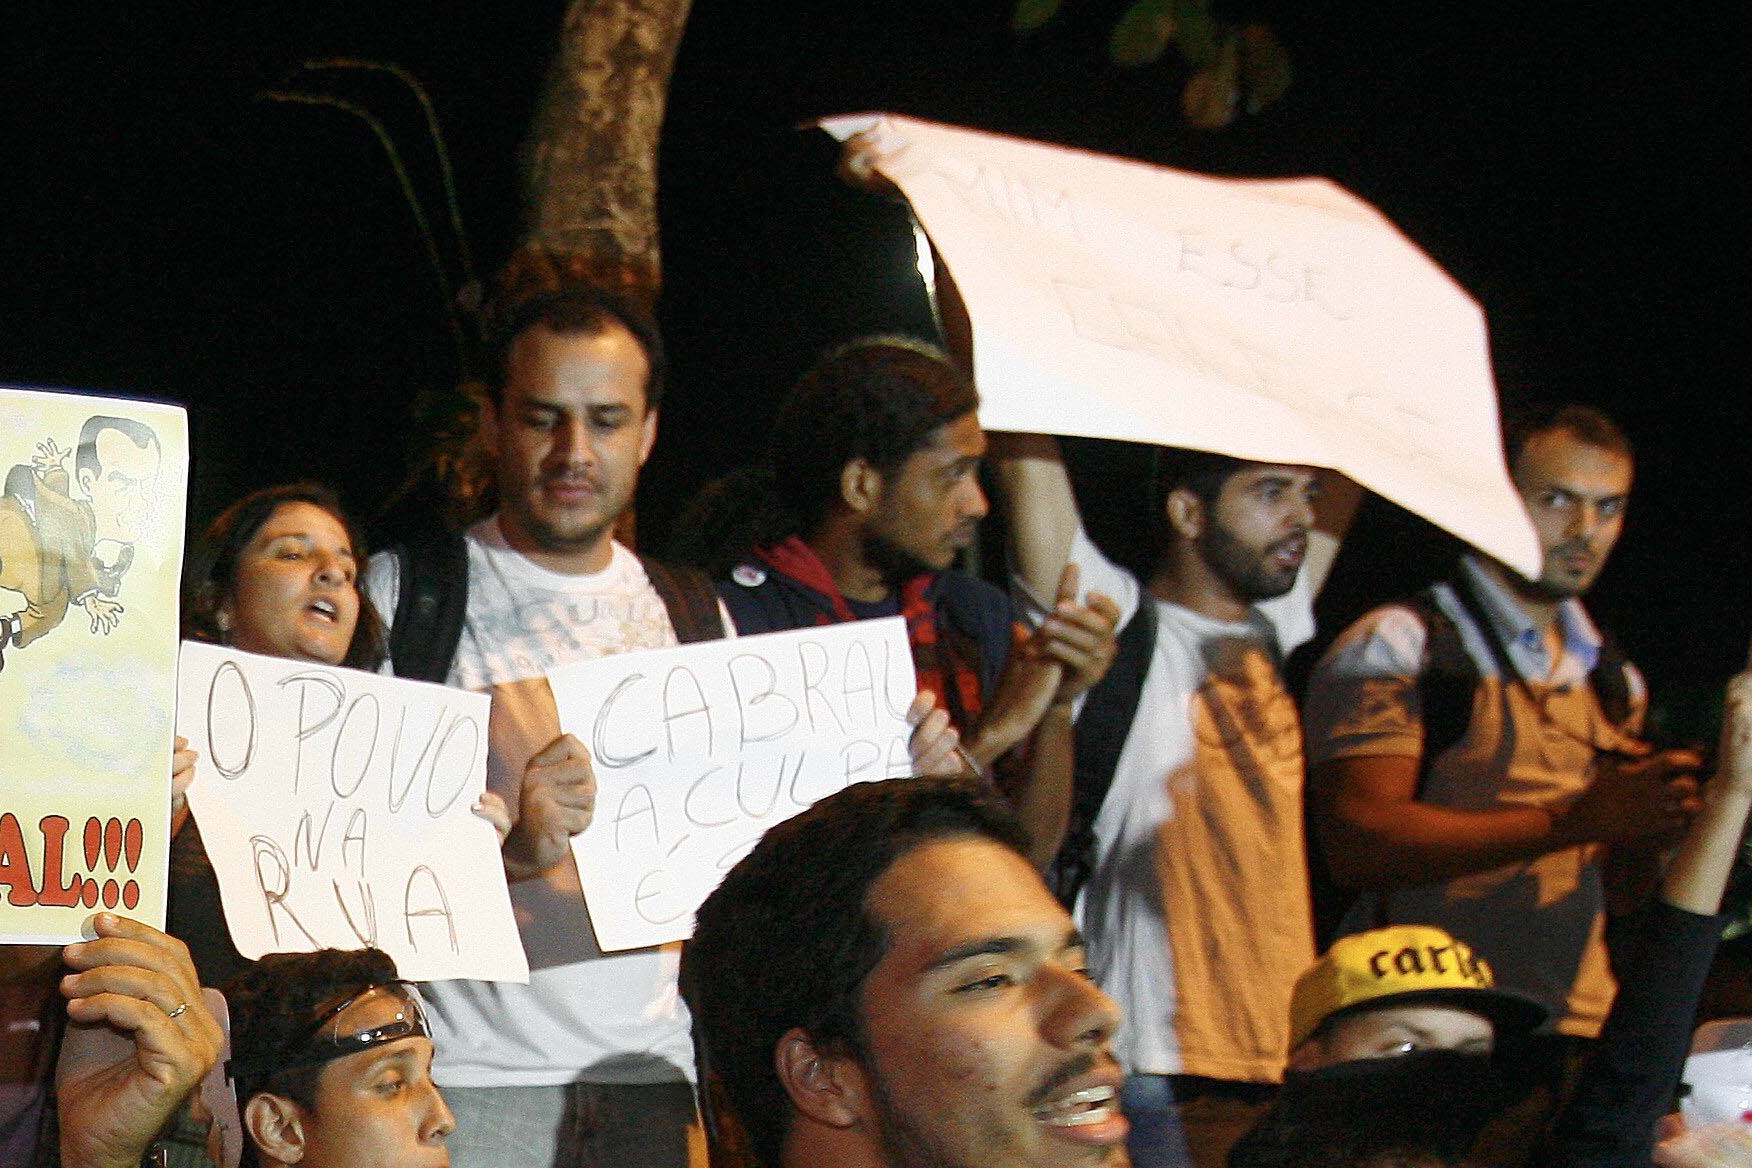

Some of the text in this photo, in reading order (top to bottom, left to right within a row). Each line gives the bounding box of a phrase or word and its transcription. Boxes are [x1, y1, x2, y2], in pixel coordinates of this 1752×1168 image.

[207, 660, 479, 819] O POVO
[592, 640, 908, 769] CABRAL
[295, 800, 367, 879] NA
[612, 784, 660, 852] A
[249, 834, 460, 956] RUA
